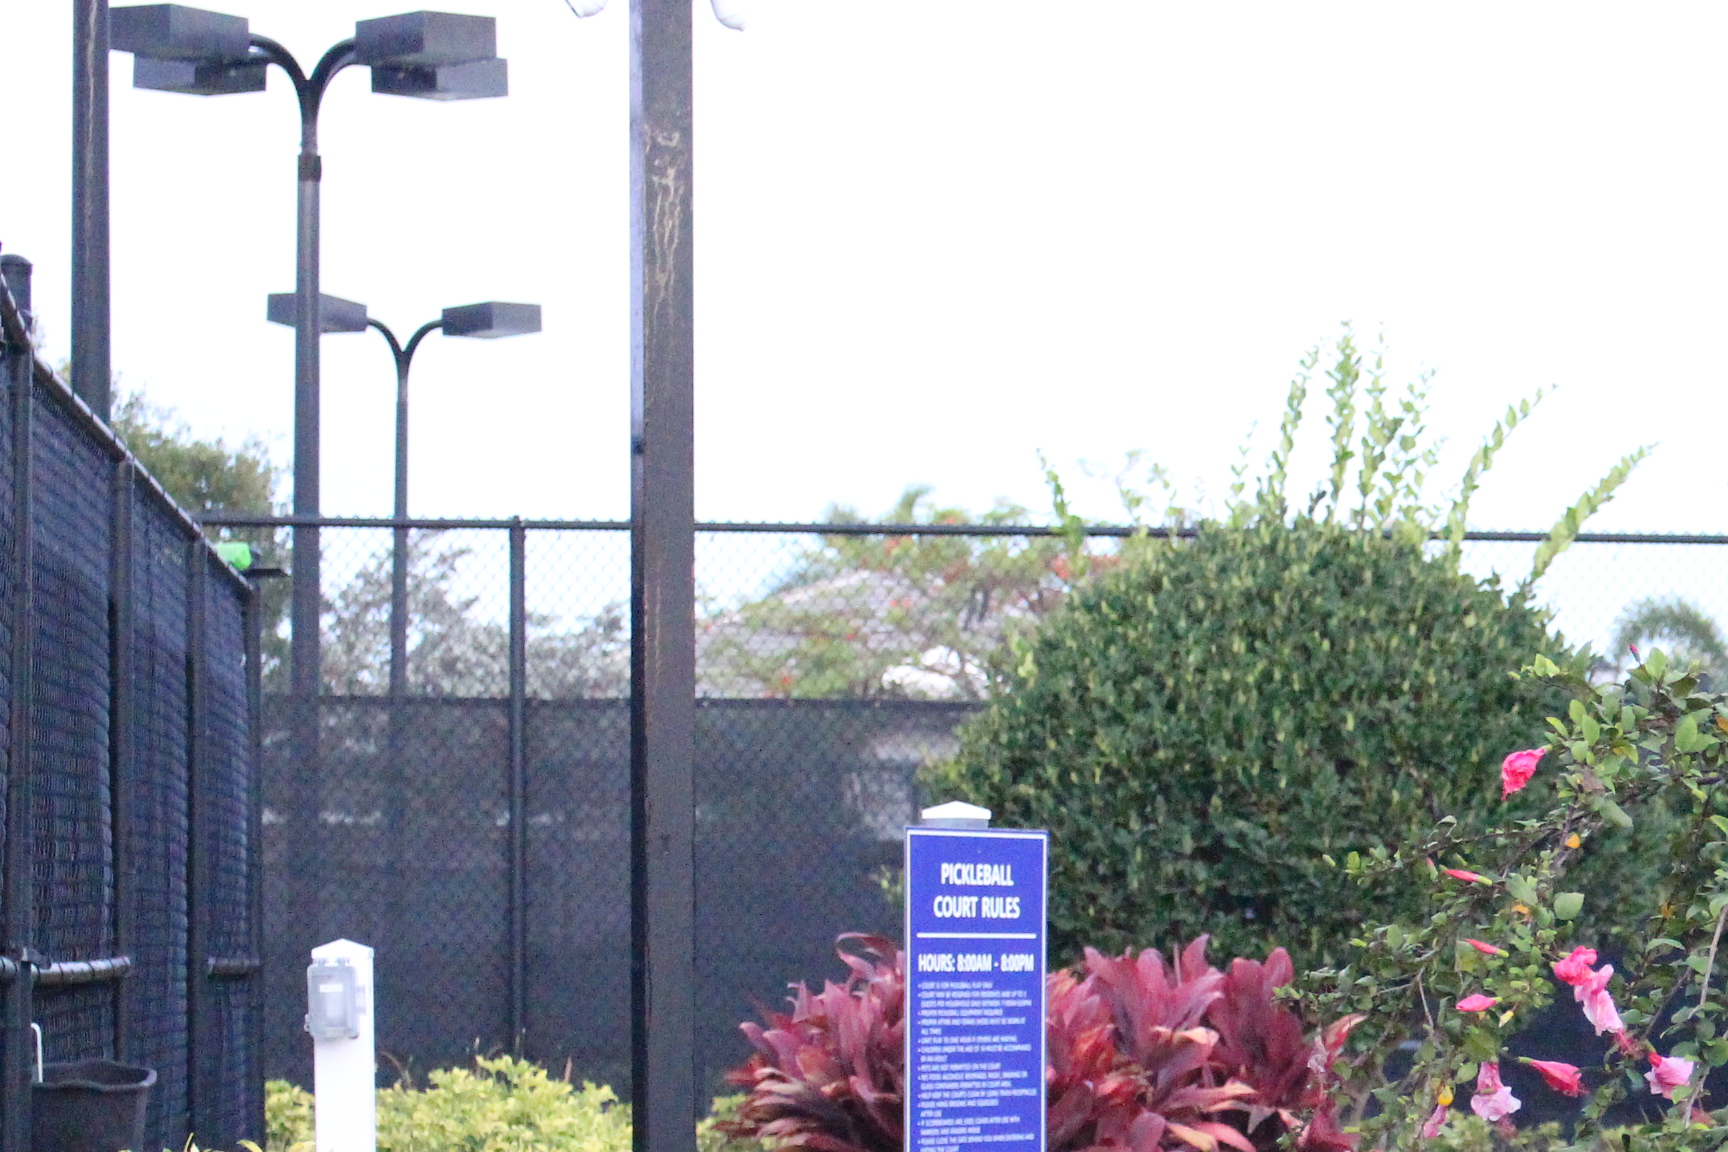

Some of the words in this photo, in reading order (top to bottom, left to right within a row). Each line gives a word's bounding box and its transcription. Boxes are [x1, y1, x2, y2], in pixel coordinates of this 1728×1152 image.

[940, 862, 1015, 886] PICKLEBALL
[933, 895, 979, 918] COURT
[981, 896, 1021, 919] RULES
[918, 953, 956, 972] HOURS:
[957, 953, 993, 972] 8:00AM
